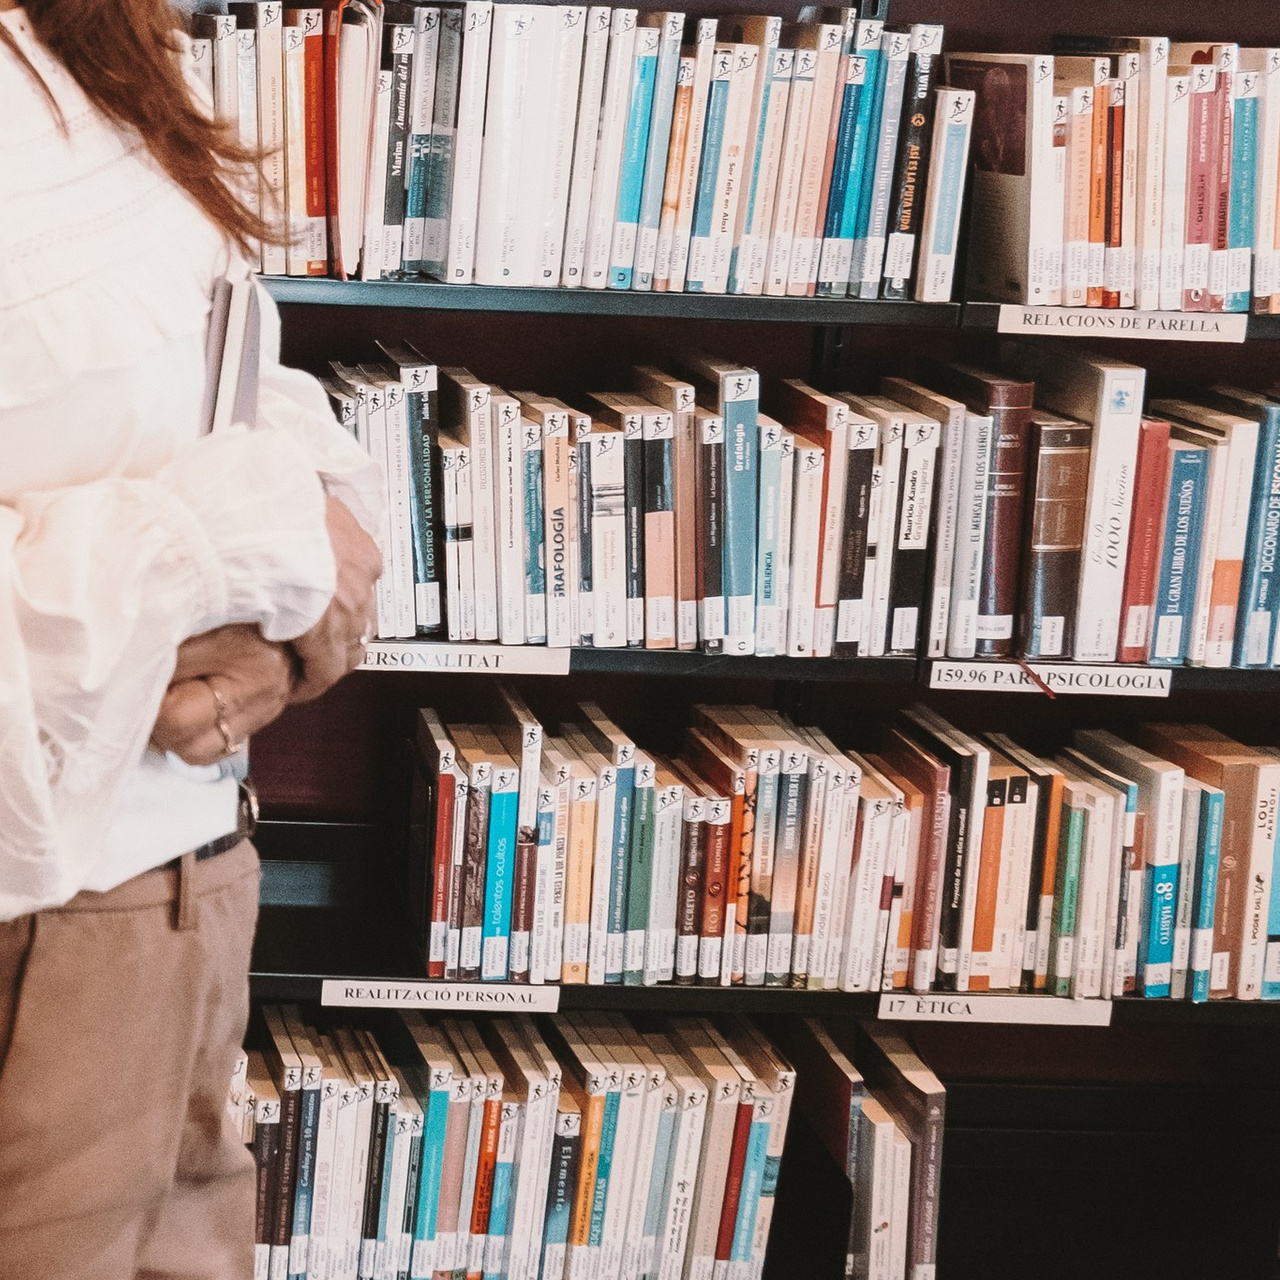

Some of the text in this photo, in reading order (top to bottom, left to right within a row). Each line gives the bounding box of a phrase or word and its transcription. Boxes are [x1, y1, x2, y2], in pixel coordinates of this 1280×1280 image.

[915, 73, 930, 99] WILD
[391, 53, 408, 176] Marina Anatomía del m
[805, 154, 819, 195] TIERNO
[898, 143, 921, 231] ASÍ ES LA PUTA VIDA
[1022, 312, 1222, 334] RELACIONS DE PARELLA
[1064, 433, 1071, 443] 3
[422, 433, 433, 505] PERSONALIDAD
[478, 446, 488, 489] DECISIONES
[917, 457, 931, 494] superior
[968, 424, 990, 543] EL MENSAJE DE LOS SUEÑOS
[424, 506, 433, 518] LA
[903, 503, 915, 541] Mauricio
[1103, 462, 1128, 569] 1000 Sueños
[1268, 495, 1280, 509] DE
[425, 529, 434, 566] ROSTRO
[1166, 478, 1194, 613] EL GRAN LIBRO DE LOS SUEÑOS
[1260, 508, 1280, 574] DICCIONARIO
[426, 568, 435, 578] EL
[763, 551, 772, 598] RESILIENCIA
[363, 651, 504, 669] ERSONALITAT
[935, 668, 988, 684] 159.96
[785, 816, 796, 826] TE
[786, 797, 798, 816] TOCA
[932, 787, 945, 837] ARENDT
[1256, 799, 1268, 828] LOU
[1265, 787, 1277, 840] MARINOFF
[713, 824, 723, 873] RHONDA BY
[950, 807, 966, 909] Proyecto de una ética mundial
[491, 836, 507, 924] talentos ocultos
[683, 888, 695, 931] SECRETO
[815, 871, 831, 940] ondat en acció
[1250, 896, 1261, 940] PODER DEL
[344, 986, 538, 1005] REALITZACIÓ PERSONAL
[887, 996, 973, 1016] 17 ÈTICA
[298, 1092, 317, 1187] Coaching en 10 minutos
[486, 1101, 499, 1153] MARK MANS
[553, 1145, 572, 1212] Elemento
[592, 1176, 608, 1212] ROJAS
